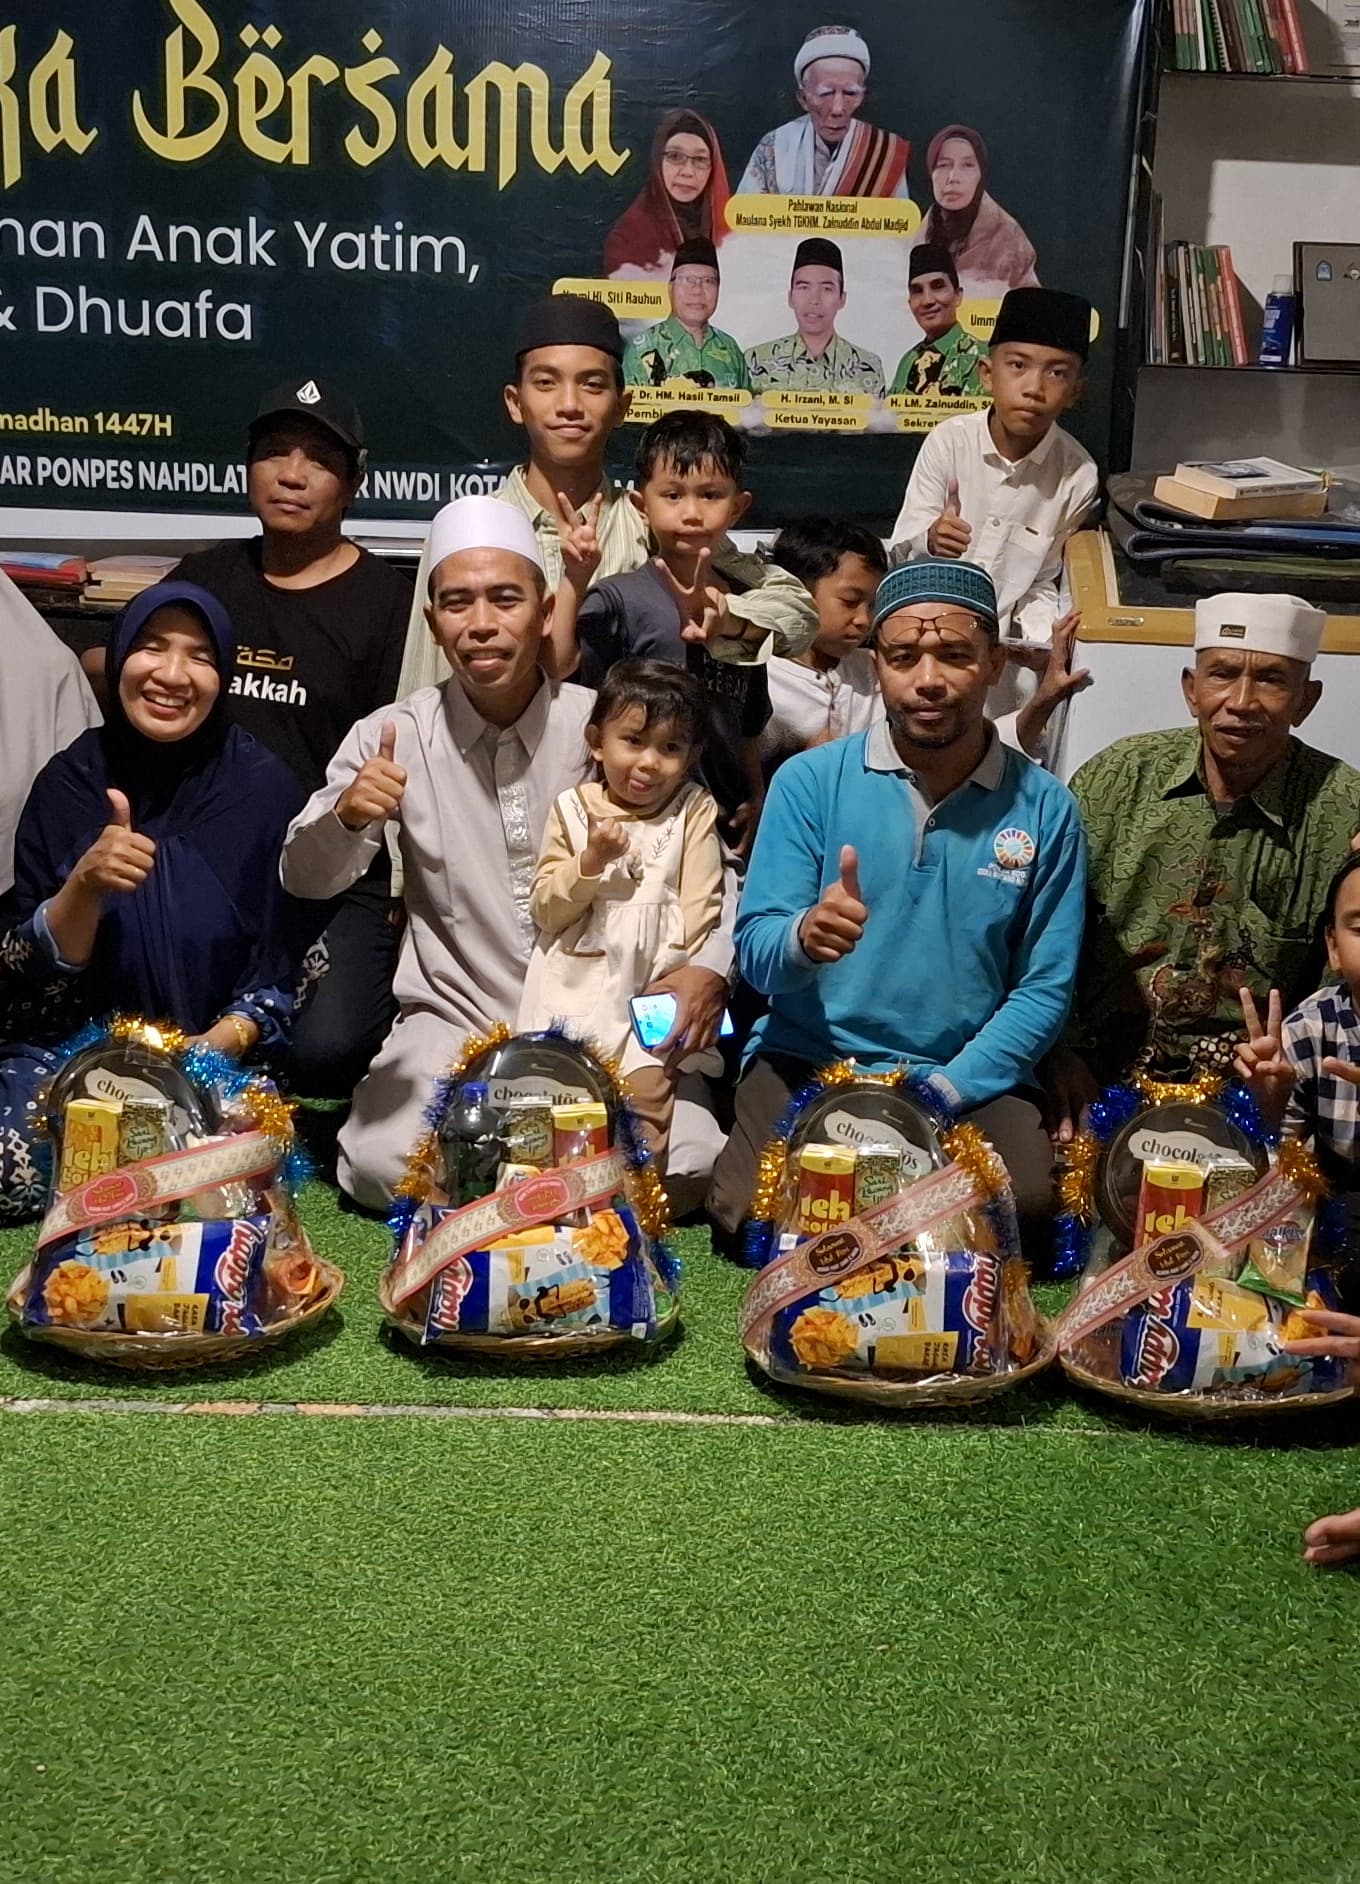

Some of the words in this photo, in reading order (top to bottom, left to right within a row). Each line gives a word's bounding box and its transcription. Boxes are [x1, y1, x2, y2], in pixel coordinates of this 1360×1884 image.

[788, 199, 824, 213] Pahlawan
[826, 200, 858, 214] Nasional
[736, 214, 767, 226] Maulana
[769, 215, 791, 229] Syekh
[822, 216, 859, 229] Zainuddin
[860, 217, 882, 229] Abdul
[884, 218, 909, 233] Madjid
[127, 214, 277, 268] Anak
[294, 219, 479, 283] Yatim,
[625, 292, 662, 305] Rauhun
[36, 285, 253, 341] Dhuafa
[970, 314, 998, 326] Umm
[639, 390, 653, 400] Dr.
[780, 394, 791, 404] H.
[828, 395, 840, 405] M.
[890, 398, 901, 408] H.
[905, 398, 922, 408] LM.
[94, 412, 173, 437] 1447H
[775, 413, 809, 424] Ketua
[811, 414, 857, 427] Yayasan
[39, 457, 134, 490] PONPES
[374, 471, 440, 501] NWDI
[801, 1189, 850, 1221] teh
